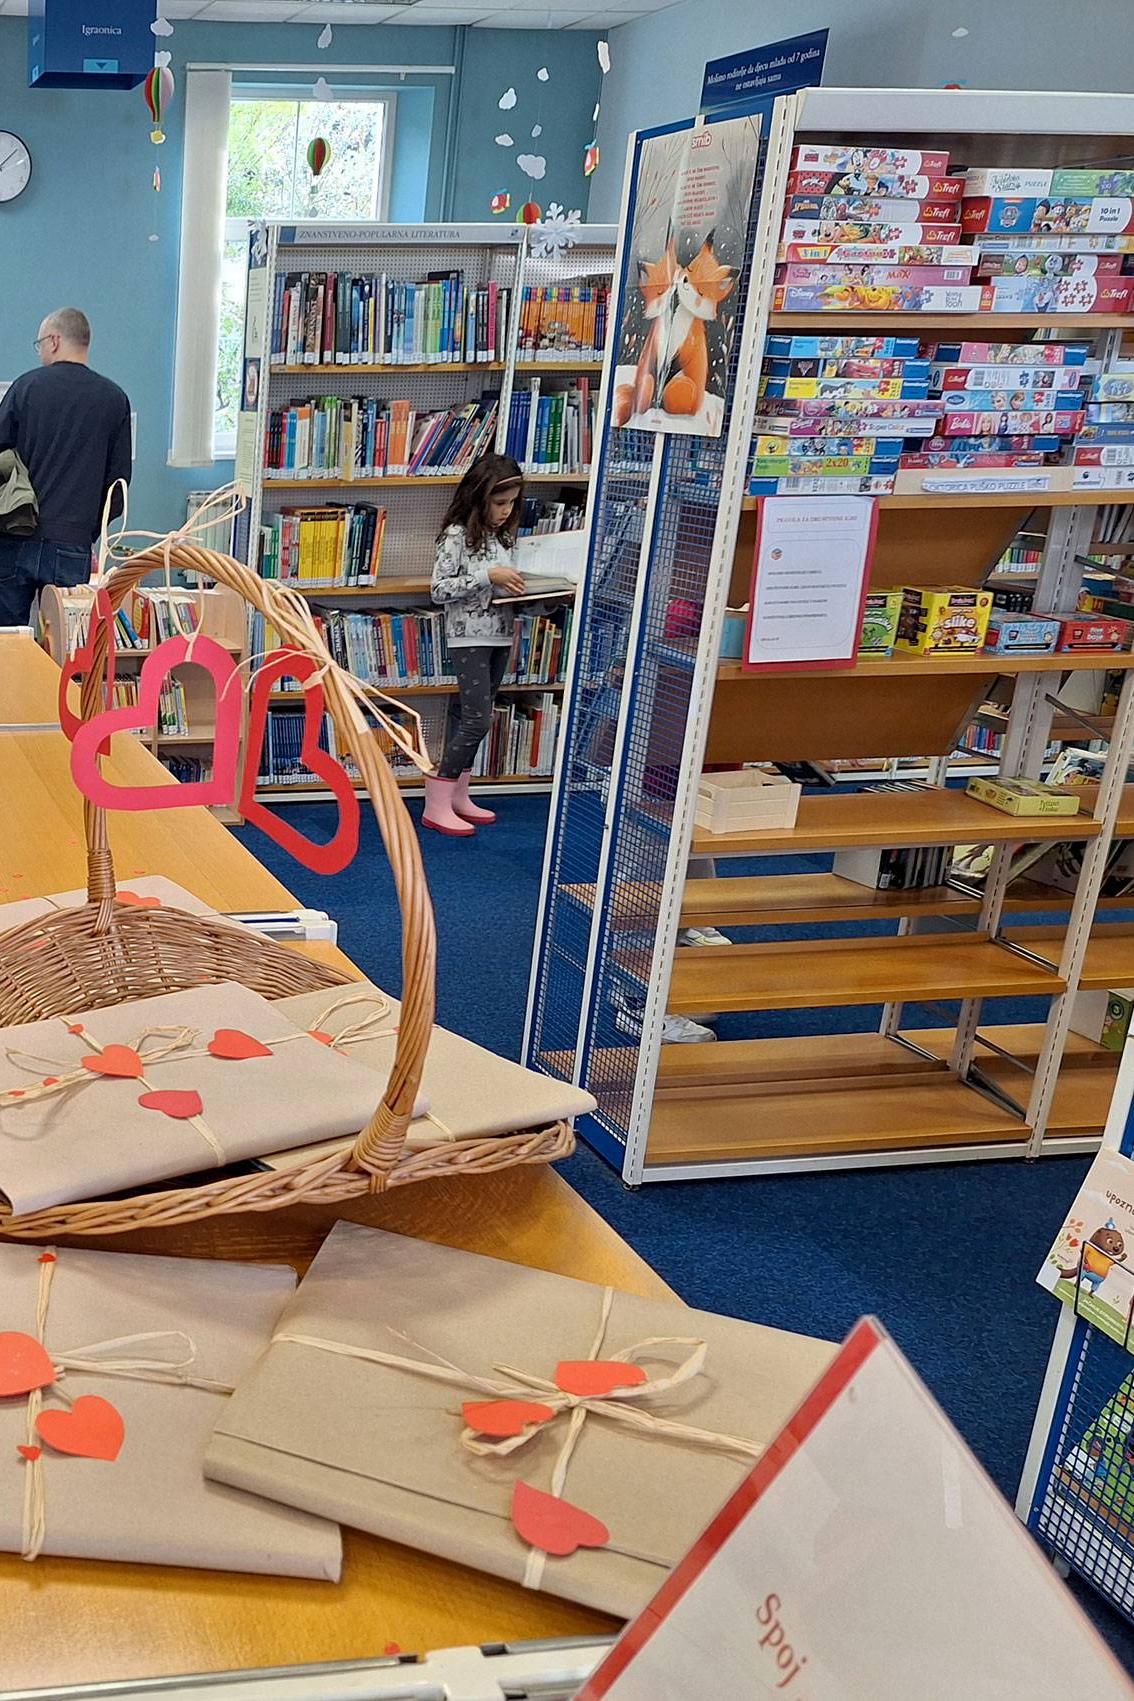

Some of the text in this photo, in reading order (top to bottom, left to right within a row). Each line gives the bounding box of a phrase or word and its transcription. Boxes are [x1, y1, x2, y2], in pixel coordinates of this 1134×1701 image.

[81, 24, 123, 36] Igraonica
[706, 73, 727, 85] Molimo
[726, 66, 747, 80] roditelje
[747, 65, 754, 75] da
[753, 61, 768, 74] djecu
[786, 52, 795, 64] od
[795, 51, 801, 63] 7
[800, 47, 821, 63] godina
[734, 82, 742, 91] ne
[742, 76, 767, 91] ostavljaju
[941, 182, 961, 194] Trefl
[932, 206, 951, 218] Trefl
[970, 208, 986, 221] Trefl
[299, 229, 461, 239] ZNANSTVENO-POPULARNA LITERATURA
[934, 230, 955, 242] Trefl
[809, 248, 820, 258] in
[1109, 288, 1129, 299] Trefl
[950, 417, 972, 431] Barbie
[825, 457, 849, 468] 2x20
[998, 481, 1026, 490] PUZZLE
[943, 614, 976, 629] slike
[757, 1595, 808, 1688] Spoj
